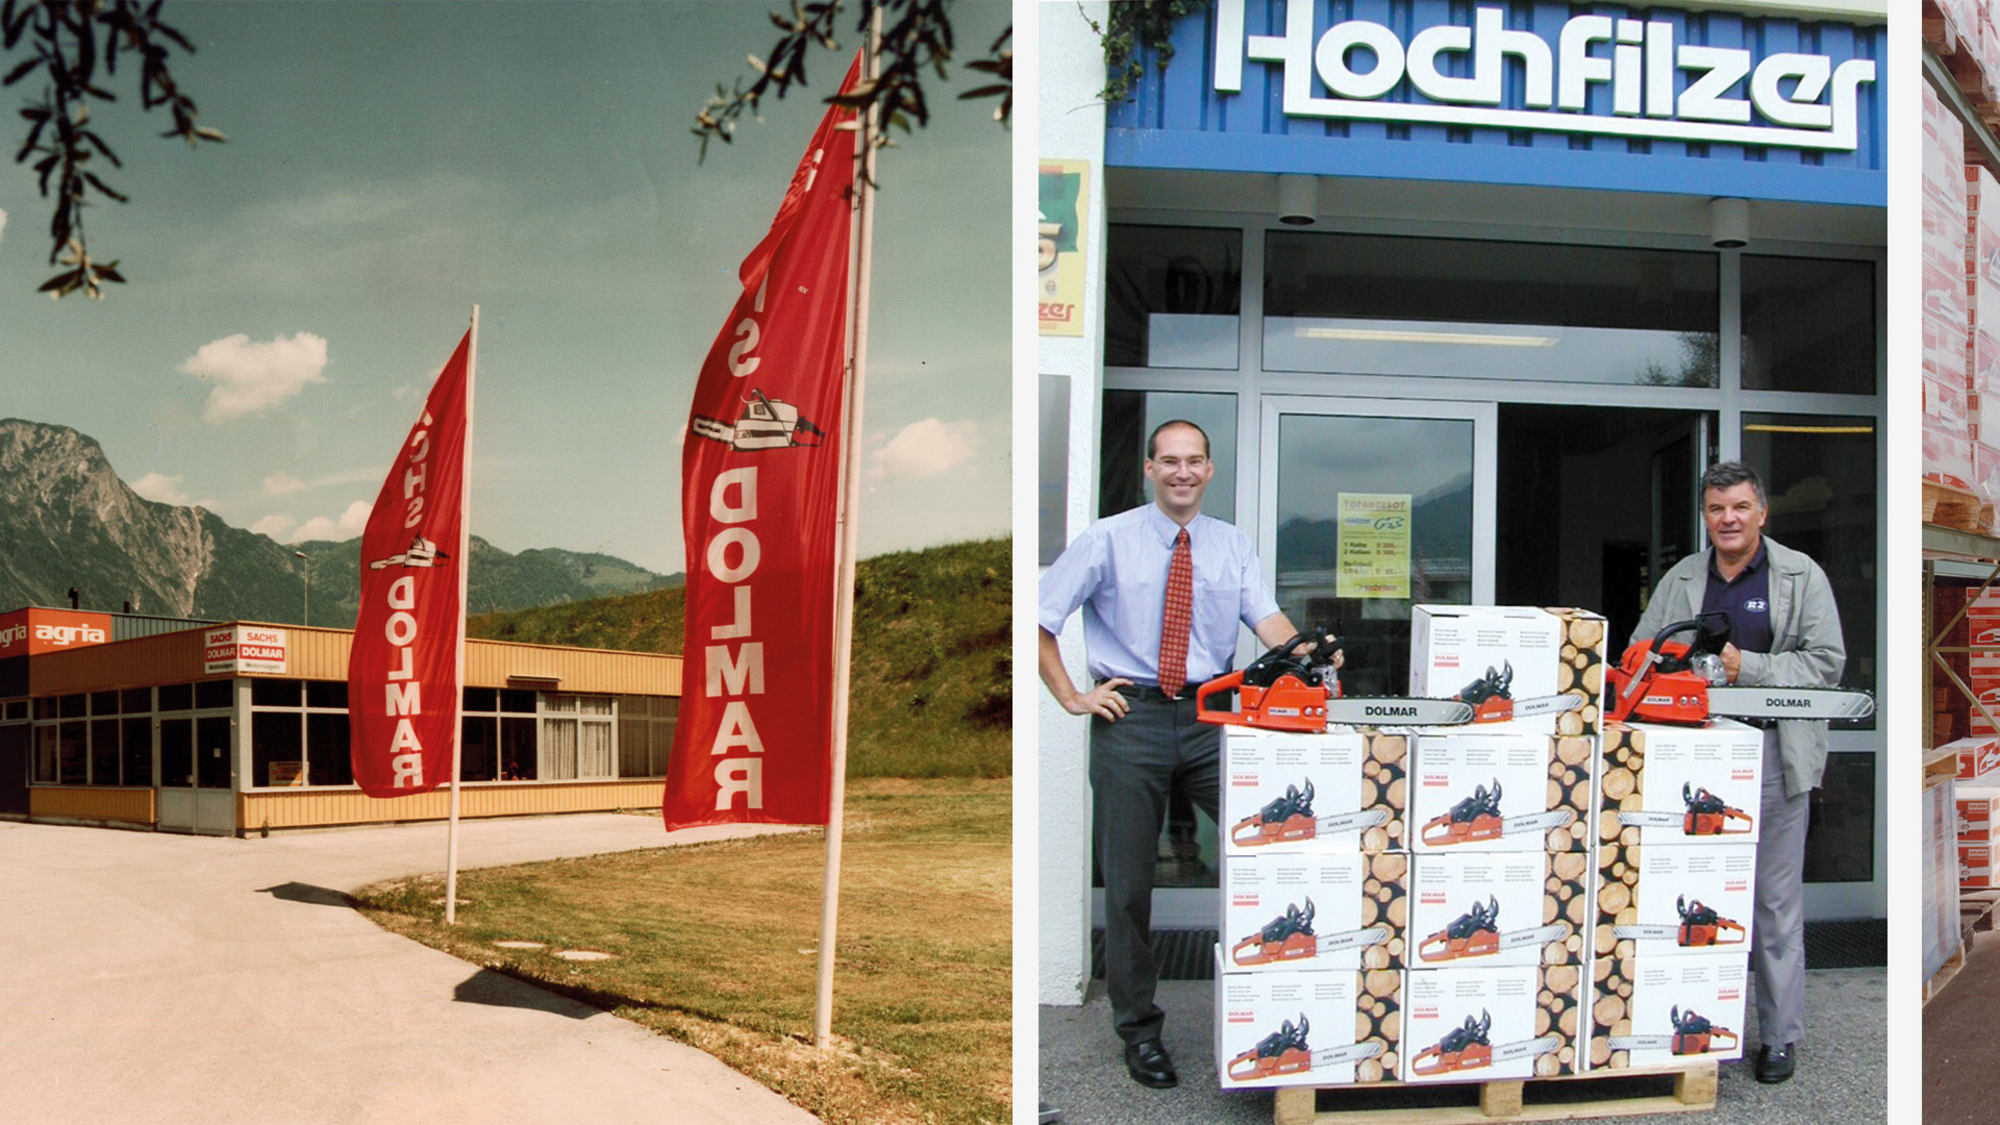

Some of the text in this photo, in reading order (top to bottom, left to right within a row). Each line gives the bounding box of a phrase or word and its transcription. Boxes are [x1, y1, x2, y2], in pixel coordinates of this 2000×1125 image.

[1213, 0, 1876, 151] Hochfilzer
[0, 623, 26, 648] gria
[36, 623, 105, 645] agria
[210, 632, 232, 644] SACHS
[246, 632, 278, 643] SACHS
[207, 647, 236, 659] DOLMAR
[242, 646, 282, 658] DOLMAR
[1525, 702, 1548, 710] DOLMAR
[1766, 698, 1811, 708] DOLMAR
[1365, 706, 1417, 716] DOLMAR
[1328, 819, 1353, 828] DOLMAR
[1514, 820, 1538, 828] DOLMAR
[1328, 937, 1354, 946] DOLMAR
[1510, 934, 1534, 943] DOLMAR
[1503, 1046, 1527, 1056] DOLMAR
[1323, 1052, 1348, 1061] DOLMAR
